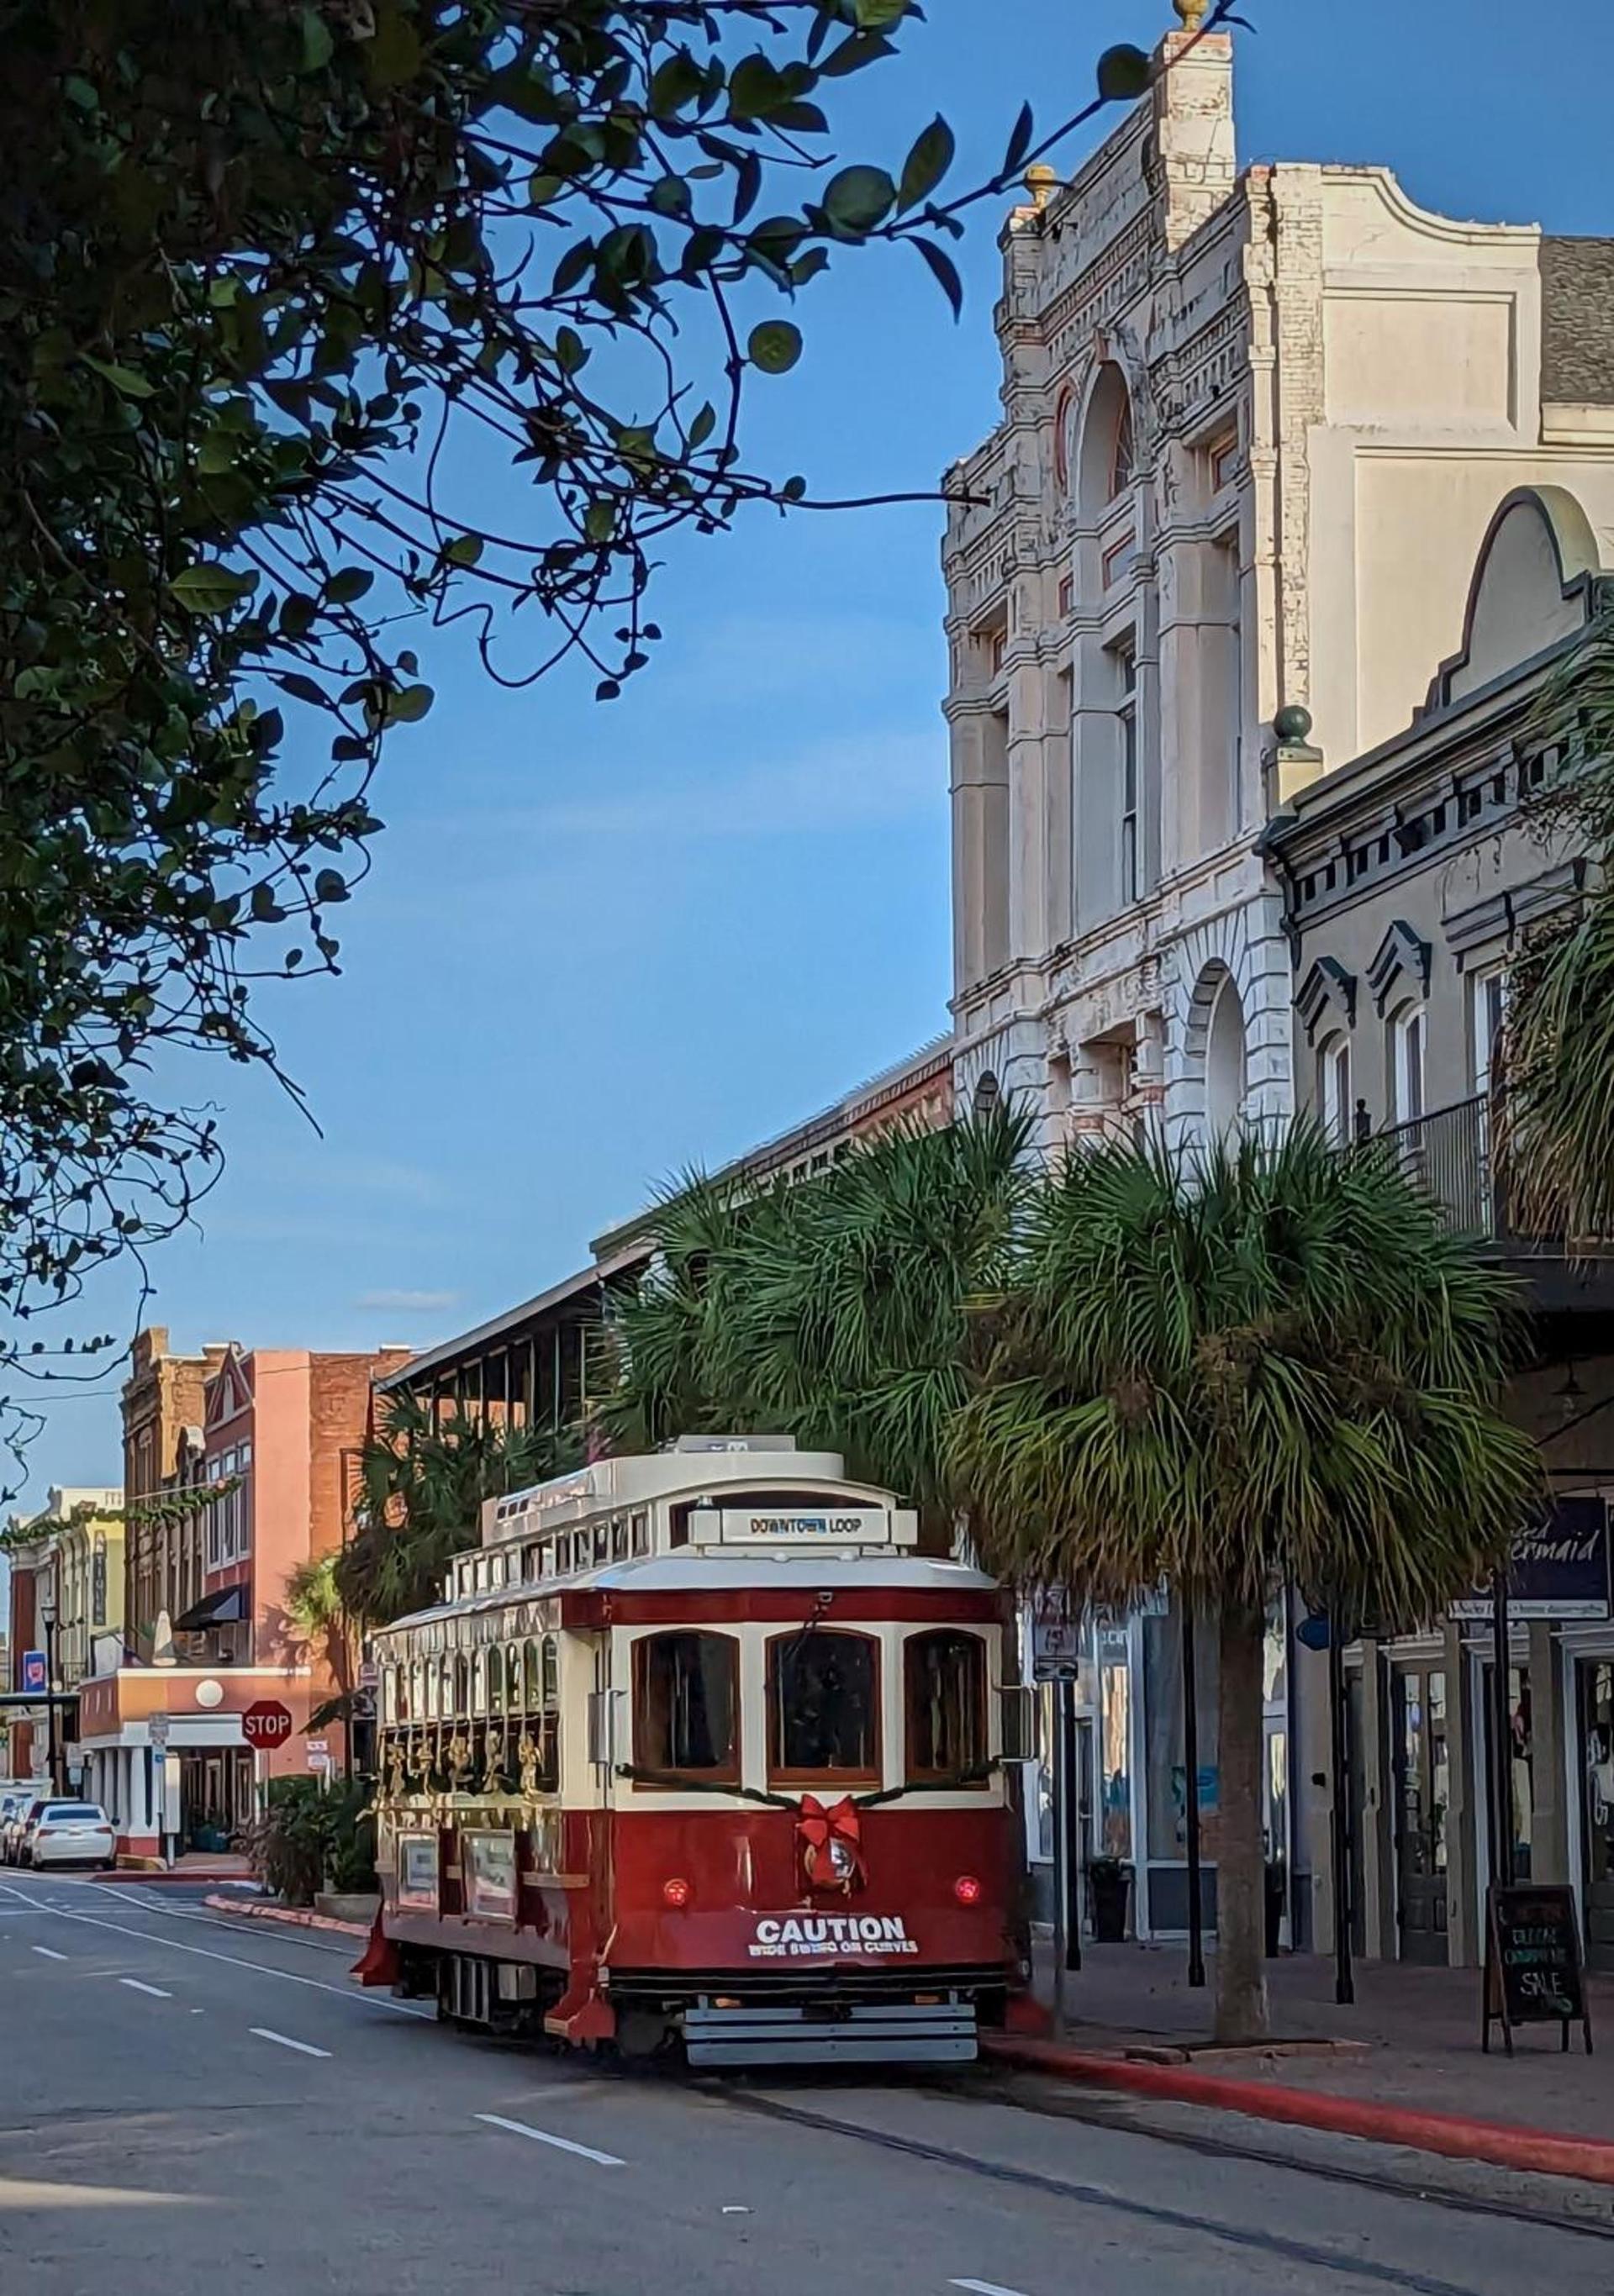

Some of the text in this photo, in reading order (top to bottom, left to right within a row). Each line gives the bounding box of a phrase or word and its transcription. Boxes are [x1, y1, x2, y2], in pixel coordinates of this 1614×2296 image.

[750, 1518, 862, 1533] DOWNTOWN LOOP
[1510, 1530, 1601, 1561] ermaid
[245, 1715, 289, 1735] STOP
[756, 1916, 906, 1944] CAUTION
[748, 1943, 787, 1956] WIDE
[841, 1941, 862, 1953] ON
[864, 1940, 919, 1954] CURVES
